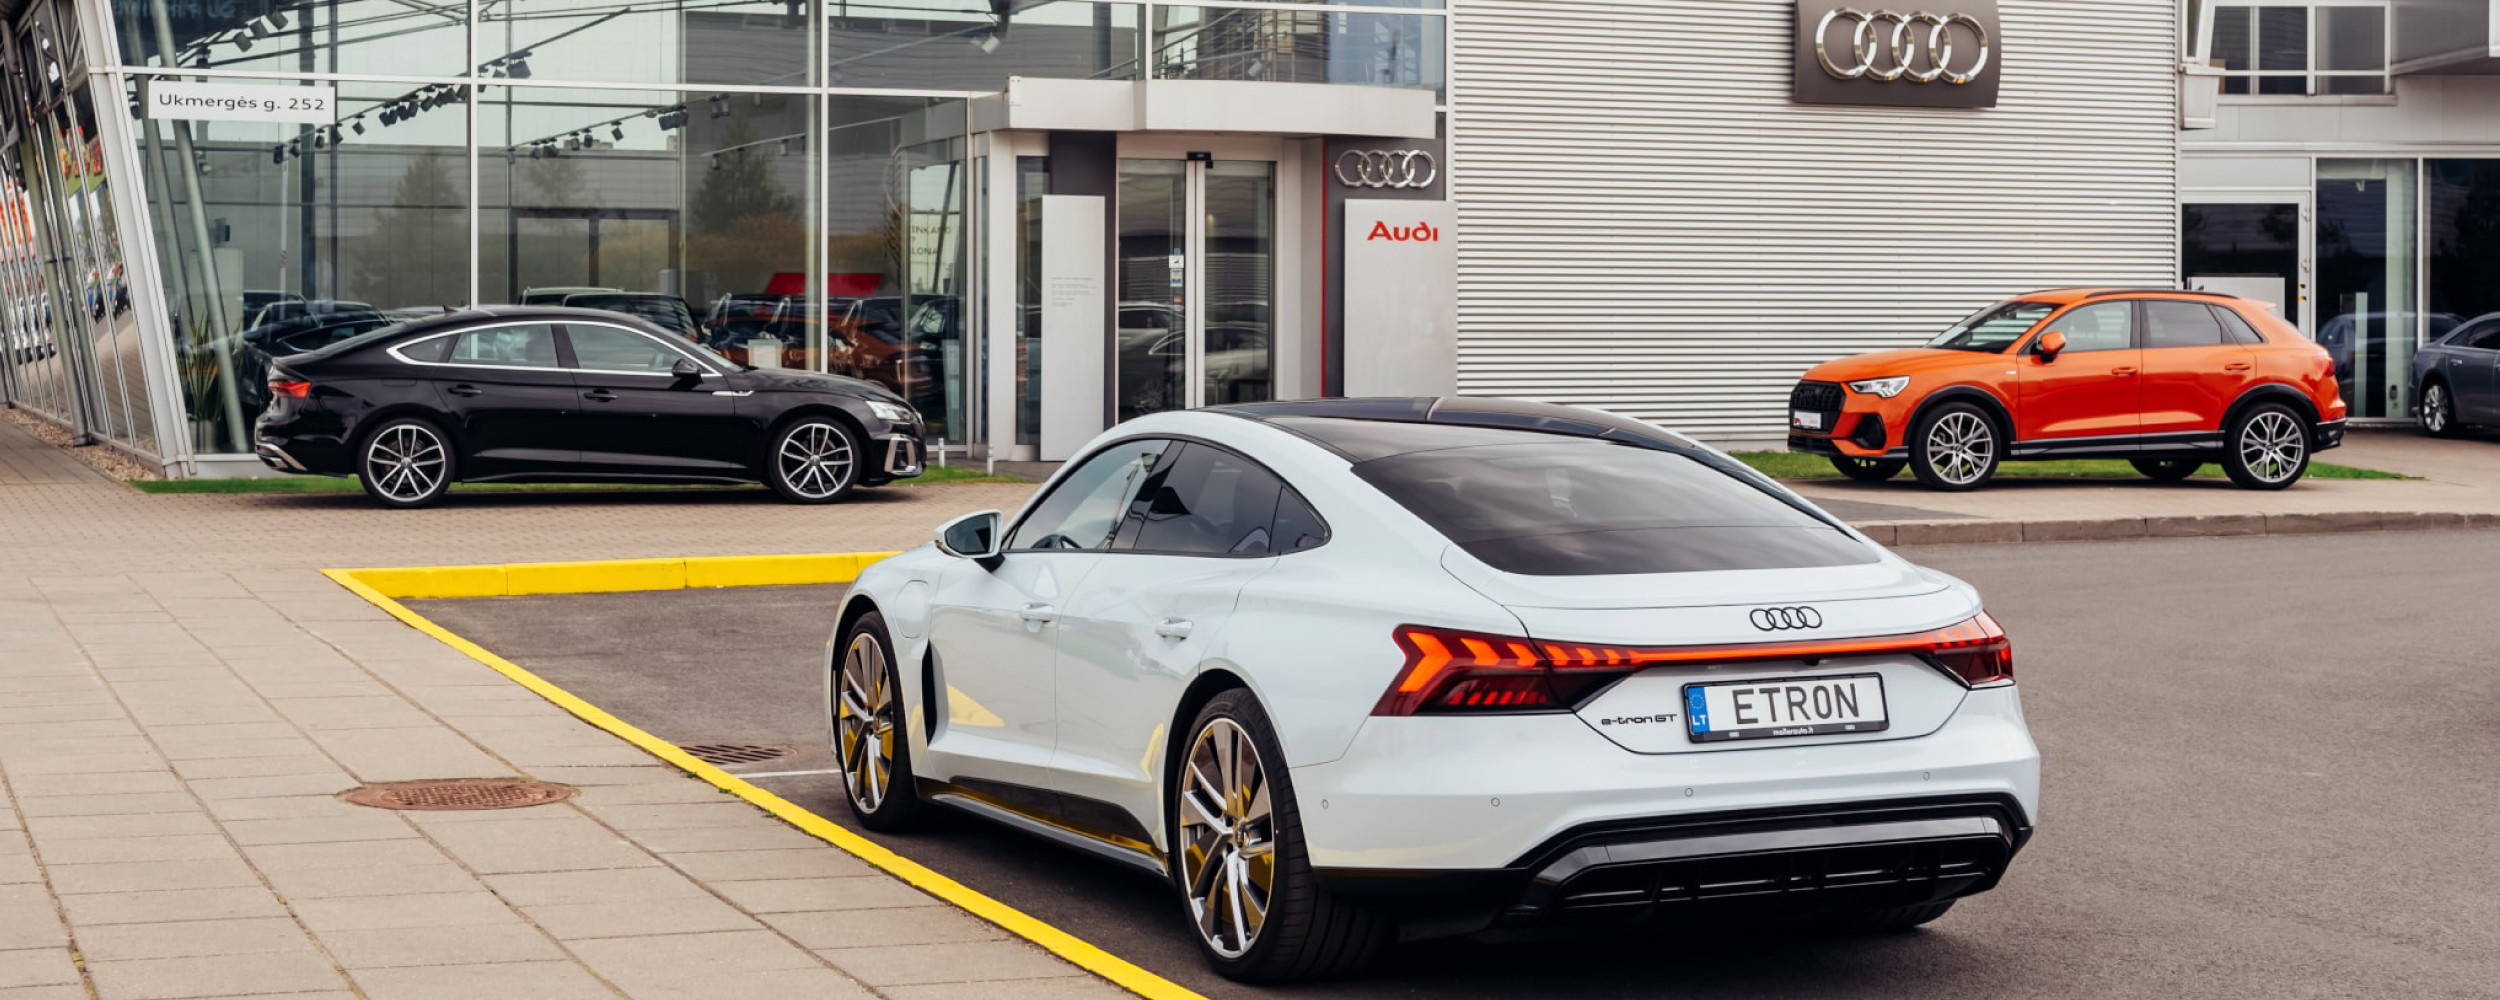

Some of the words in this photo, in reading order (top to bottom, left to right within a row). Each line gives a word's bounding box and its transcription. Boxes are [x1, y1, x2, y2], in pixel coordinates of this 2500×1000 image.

[159, 93, 257, 111] Ukmergės
[263, 100, 281, 112] g.
[288, 98, 325, 111] 252
[1367, 220, 1439, 242] Audi
[1732, 682, 1860, 725] ETRON
[1601, 716, 1653, 725] e-tron
[1655, 713, 1677, 722] GT
[1692, 714, 1707, 726] LT
